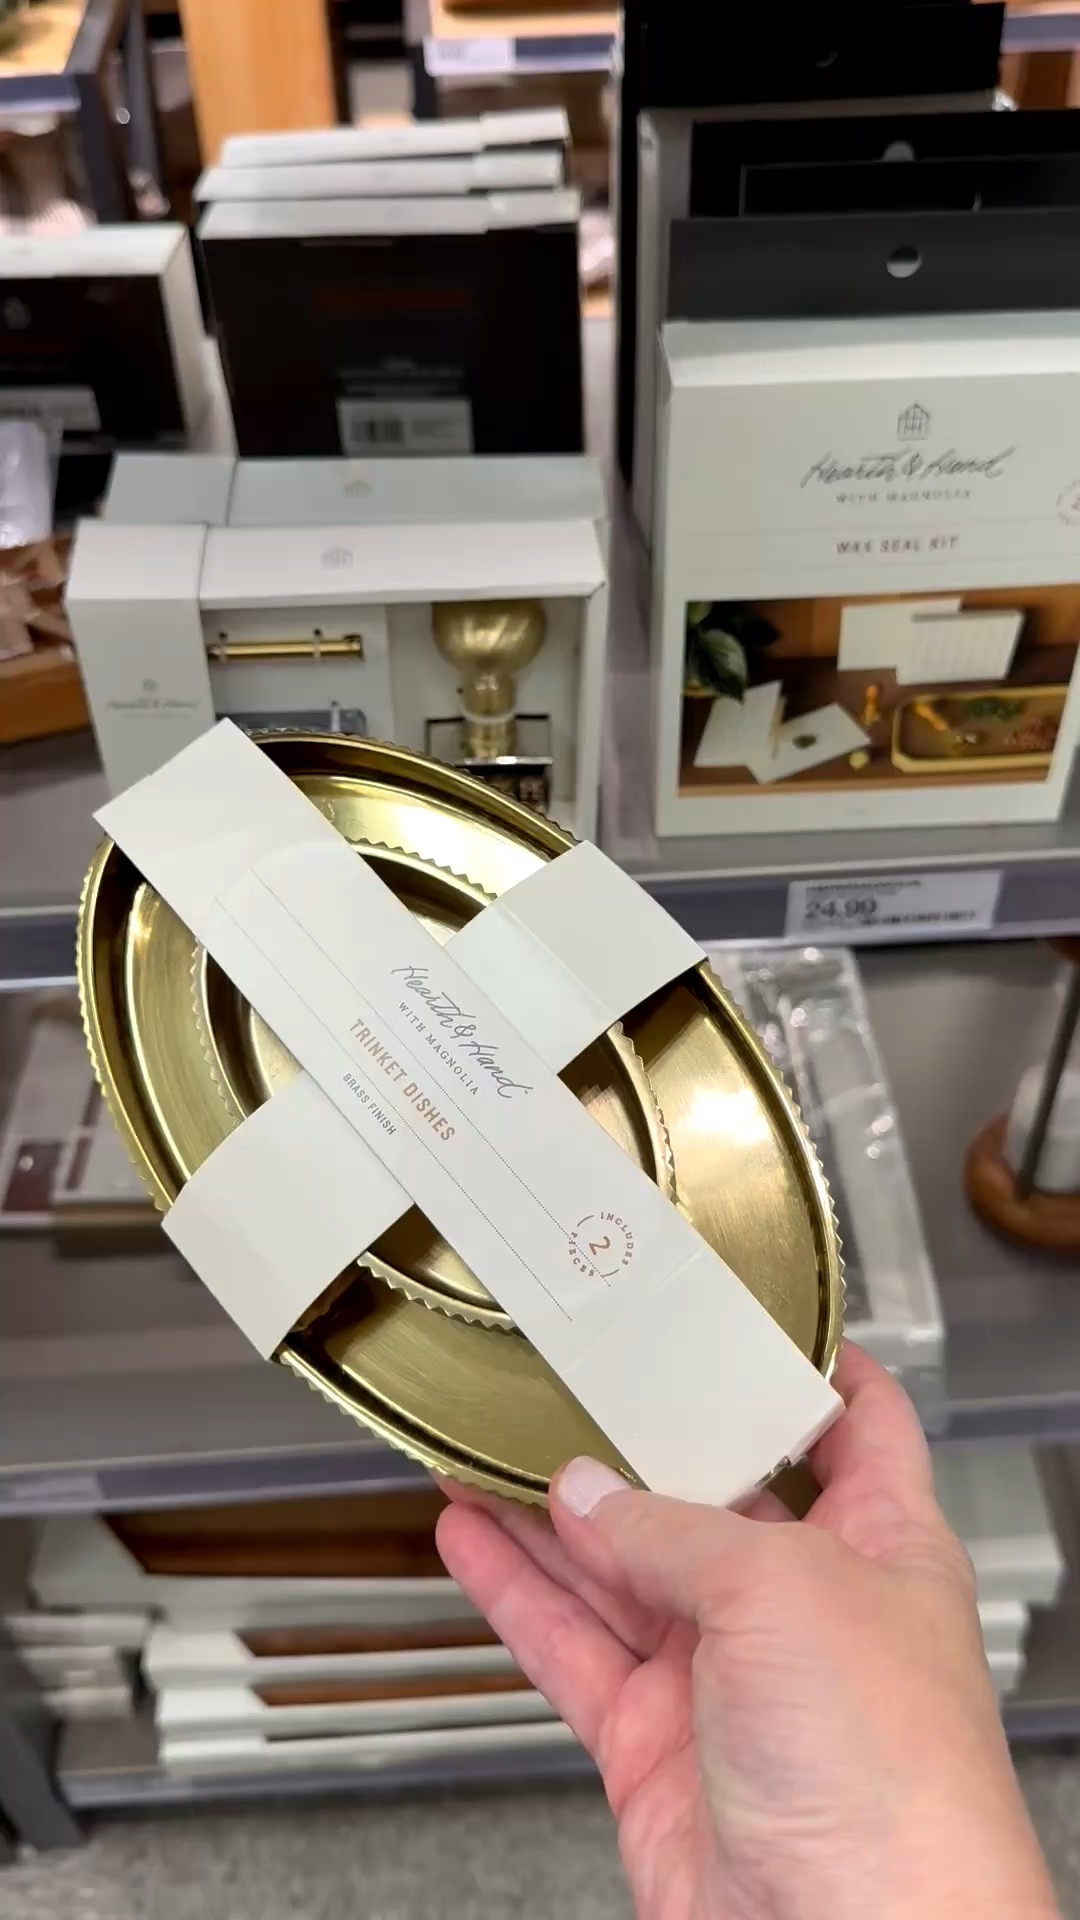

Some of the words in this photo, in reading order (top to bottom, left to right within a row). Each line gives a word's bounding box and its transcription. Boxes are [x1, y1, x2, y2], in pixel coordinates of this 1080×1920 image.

[391, 965, 476, 1029] Hearth
[398, 1001, 426, 1033] WITH
[425, 1033, 479, 1095] MAGNOLIA
[449, 1023, 477, 1040] &
[349, 1019, 407, 1083] TRINKET
[404, 1082, 456, 1141] DISHES
[458, 1040, 534, 1099] Hand
[342, 1073, 370, 1104] BRASS
[368, 1103, 396, 1136] FINISH
[568, 1231, 595, 1277] PIECES
[588, 1235, 611, 1256] 2
[600, 1211, 634, 1266] INCLUDES
